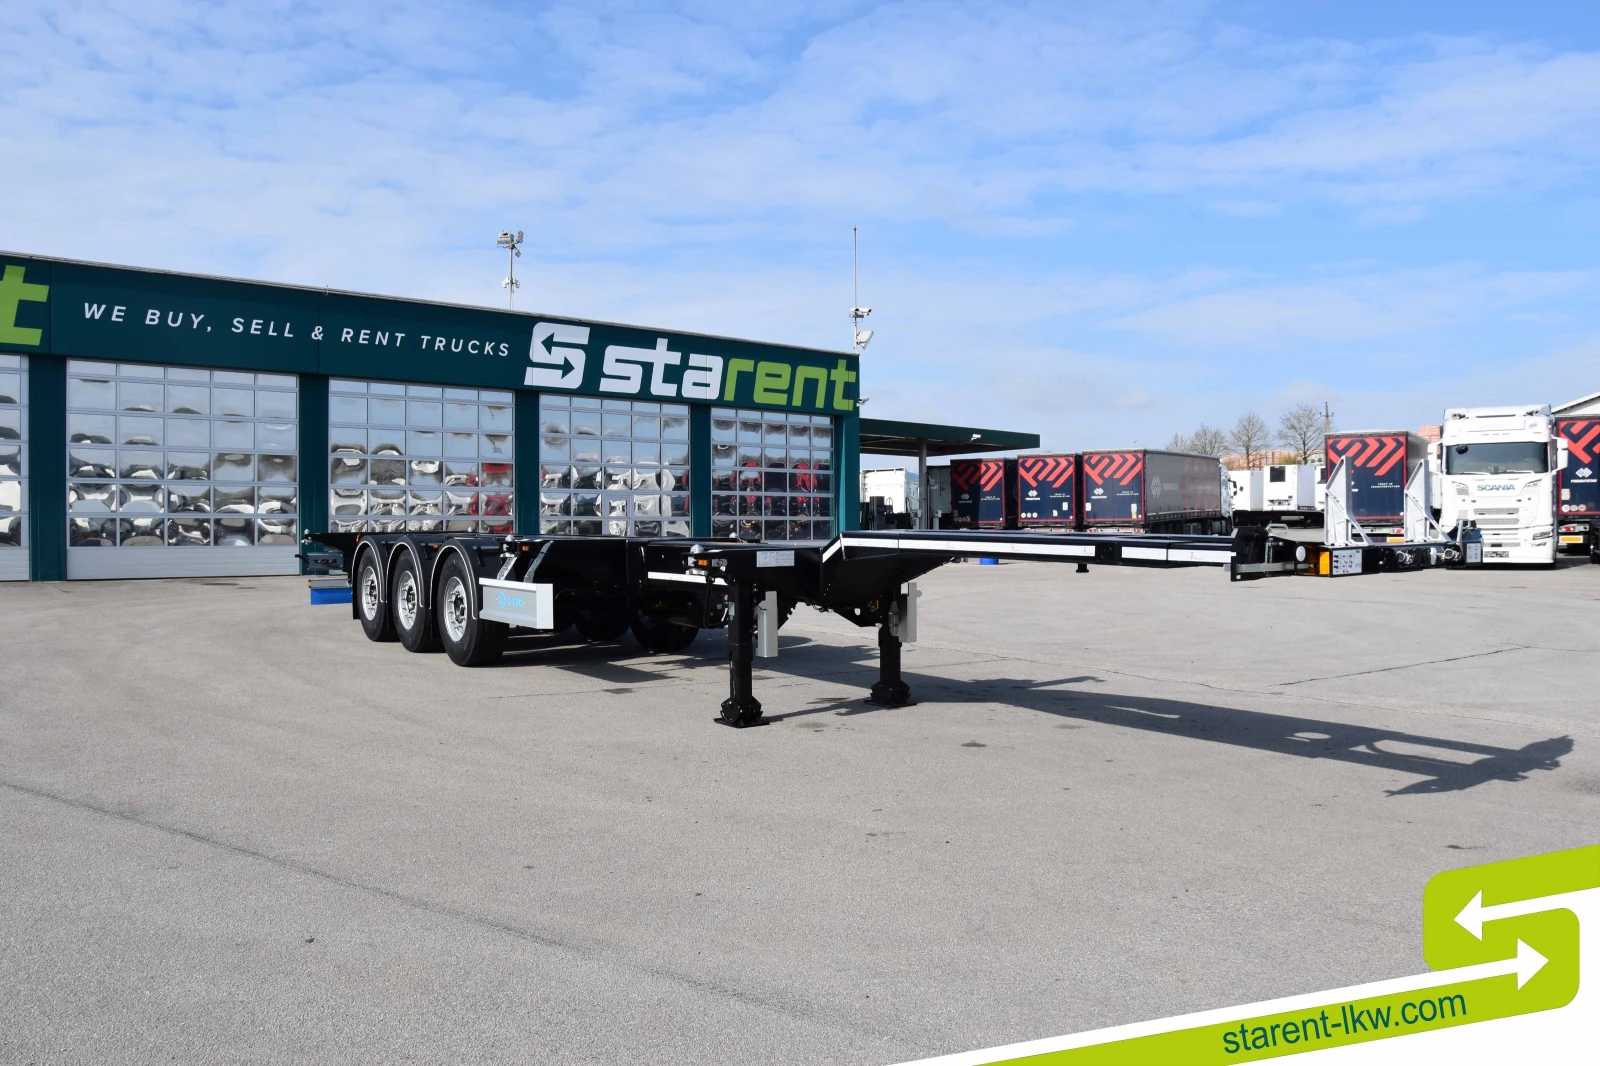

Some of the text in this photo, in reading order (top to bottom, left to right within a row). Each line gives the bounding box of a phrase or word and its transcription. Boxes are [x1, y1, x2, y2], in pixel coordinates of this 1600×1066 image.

[84, 302, 509, 357] WE BUY, SELL & RENT TRUCKS
[599, 337, 857, 411] starent
[1476, 484, 1516, 492] SCANIA
